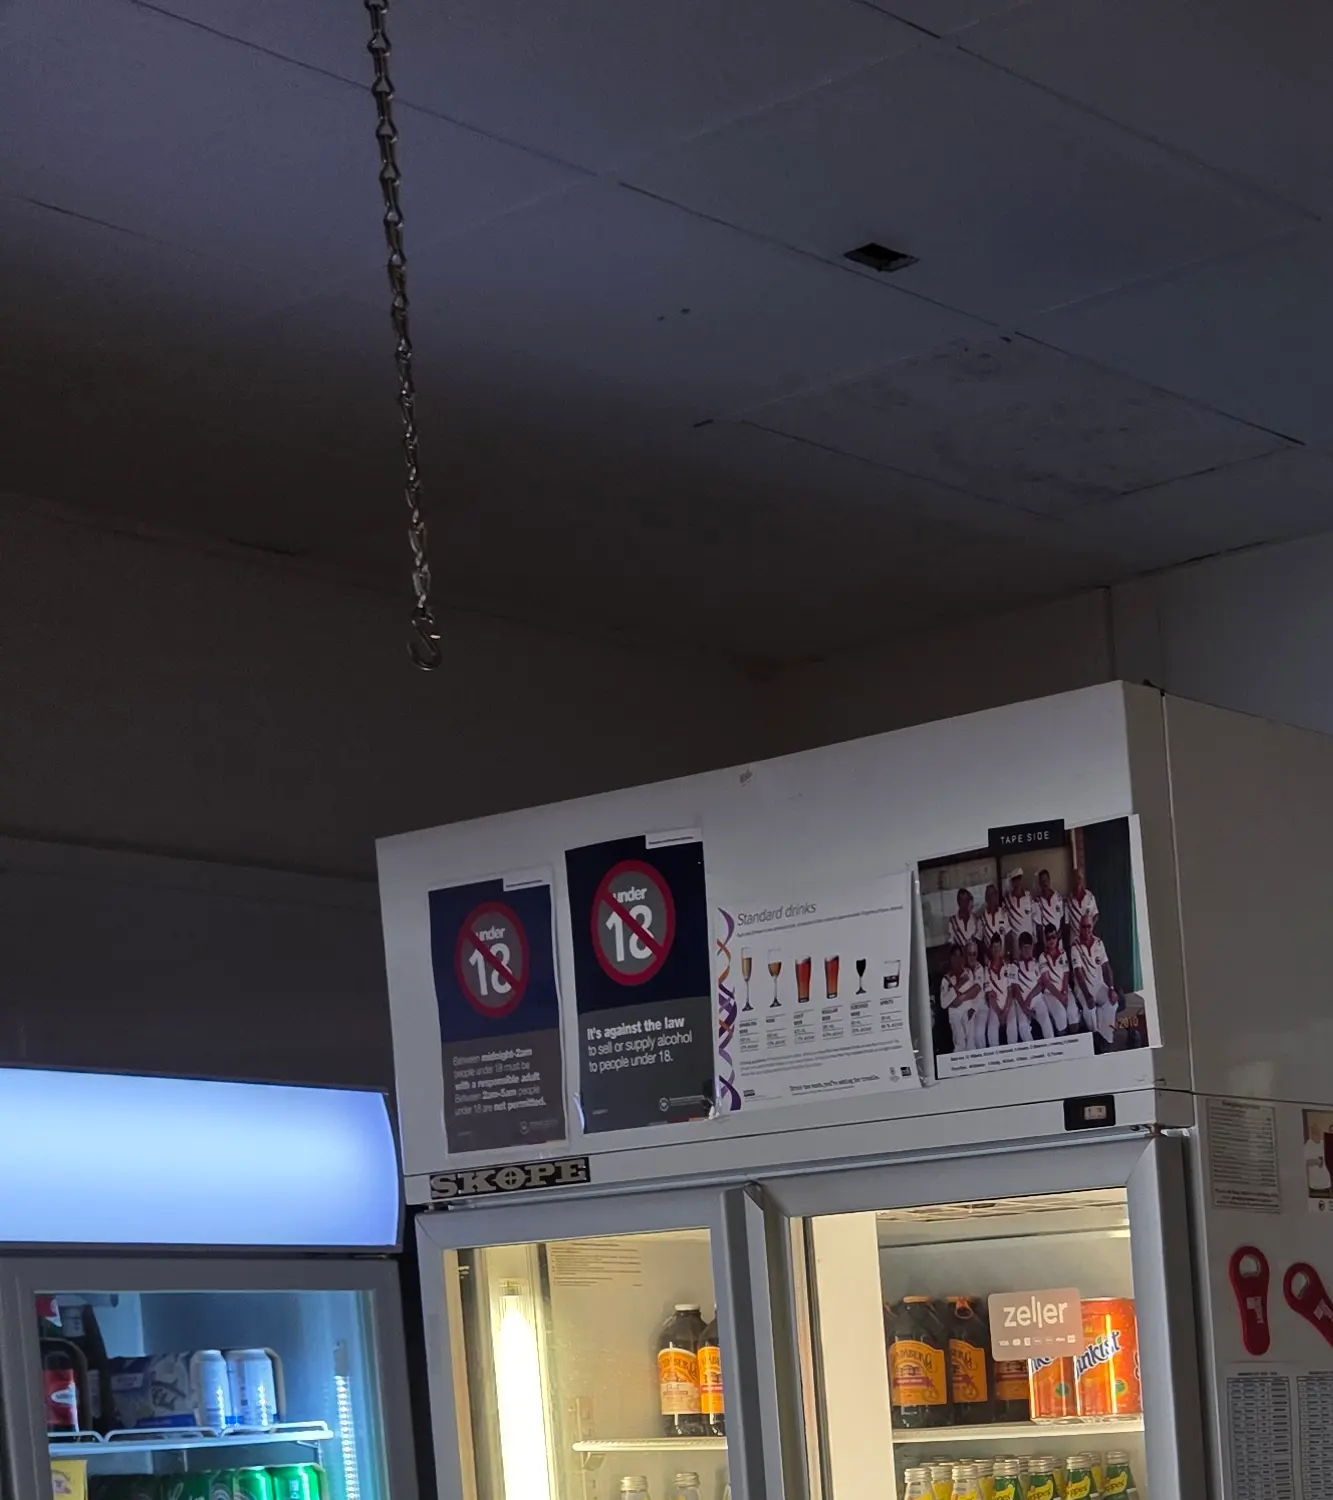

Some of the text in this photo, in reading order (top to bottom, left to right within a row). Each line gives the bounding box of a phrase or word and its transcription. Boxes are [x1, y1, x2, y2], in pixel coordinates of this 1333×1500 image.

[1000, 830, 1050, 845] TAPE SIDE
[612, 885, 648, 903] under
[736, 905, 784, 928] Standard
[784, 901, 818, 918] drinks
[604, 903, 655, 963] 18
[468, 943, 513, 997] 18
[586, 1016, 685, 1041] It's against the law
[588, 1029, 693, 1057] to sell or supply alcohol
[588, 1052, 657, 1074] to people under
[430, 1158, 590, 1199] SKOPE
[1003, 1296, 1068, 1329] zeller
